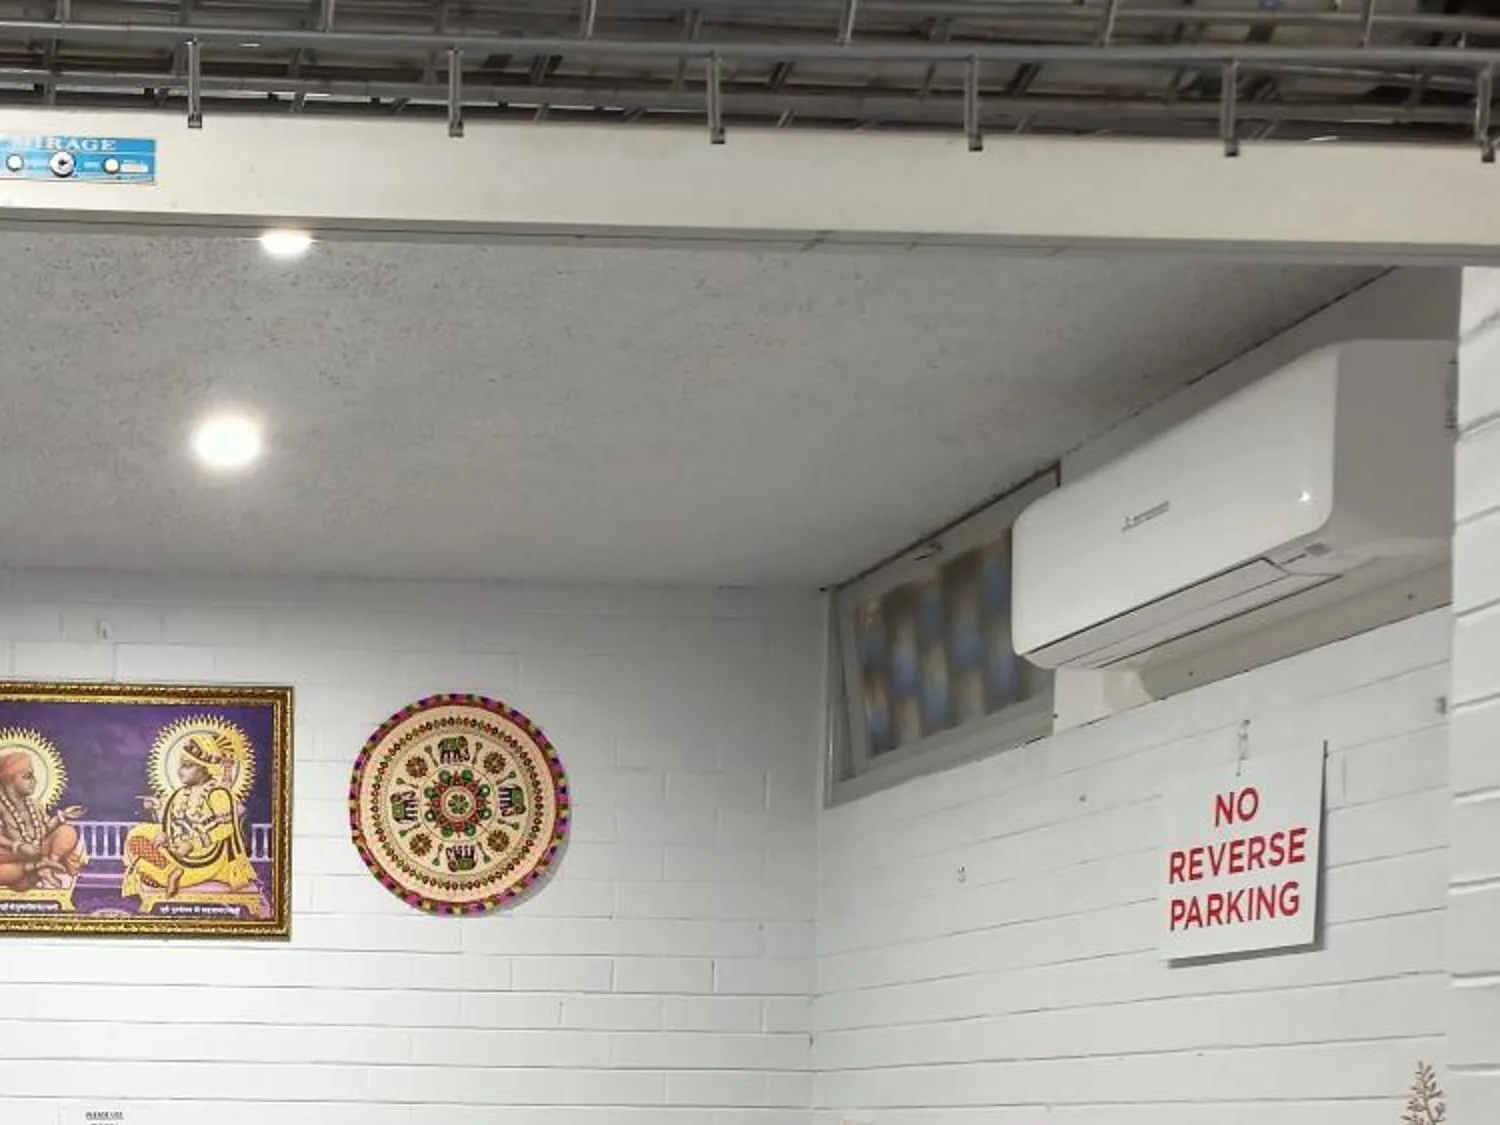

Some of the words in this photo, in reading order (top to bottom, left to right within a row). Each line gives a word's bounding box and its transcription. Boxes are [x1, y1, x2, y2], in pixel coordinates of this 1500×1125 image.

[1213, 787, 1259, 827] NO
[1168, 827, 1308, 885] REVERSE
[1169, 881, 1301, 932] PARKING
